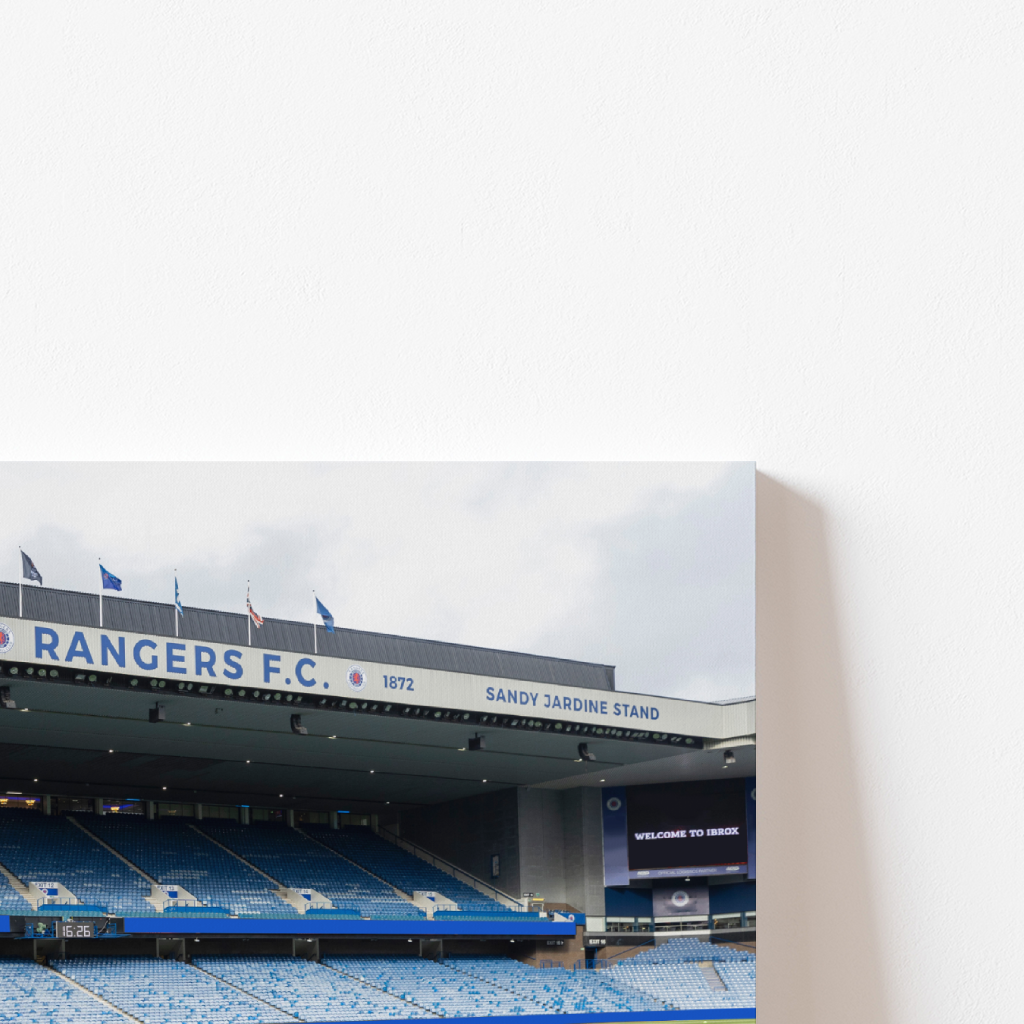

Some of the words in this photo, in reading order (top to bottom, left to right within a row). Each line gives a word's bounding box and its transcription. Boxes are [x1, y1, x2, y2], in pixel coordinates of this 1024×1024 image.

[34, 626, 244, 680] RANGERS
[262, 653, 330, 690] F.C.
[382, 674, 415, 691] 1872
[486, 687, 539, 707] SANDY
[544, 694, 609, 715] JARDINE
[613, 703, 660, 721] STAND
[634, 830, 687, 840] WELCOME
[689, 829, 704, 838] TO
[706, 827, 740, 837] IBROX
[62, 925, 91, 937] 16:26
